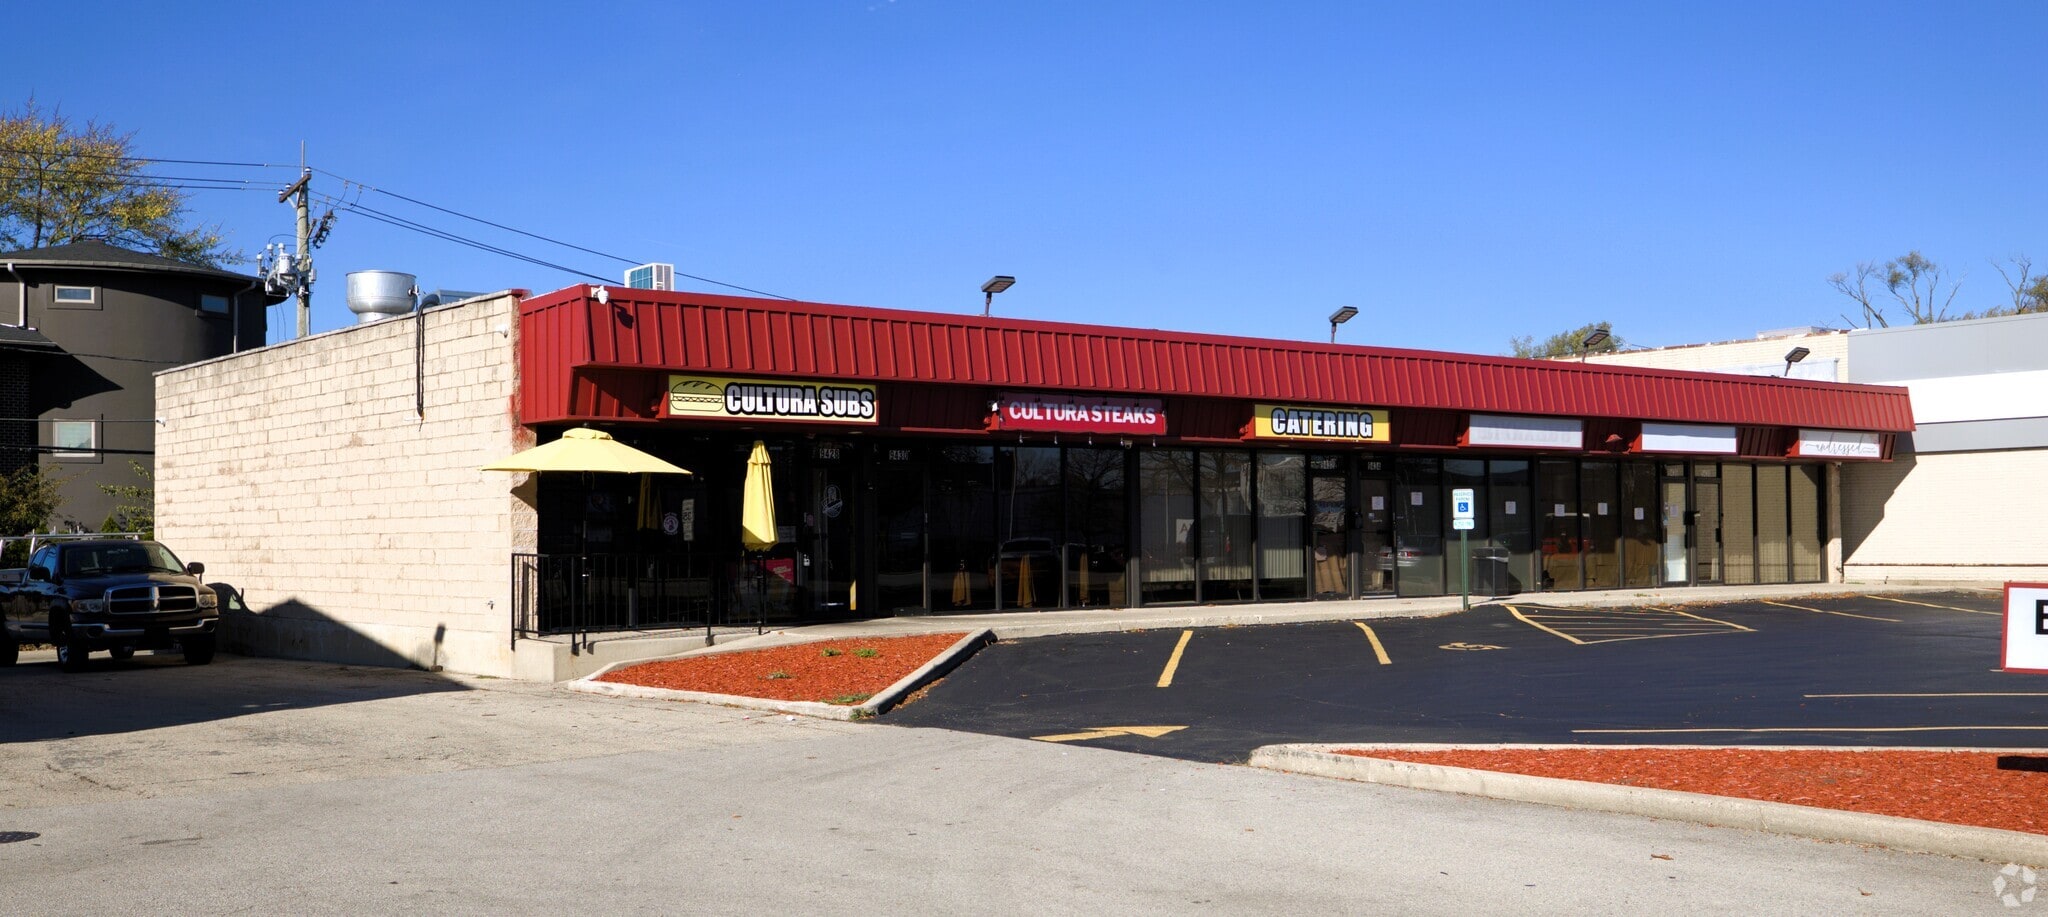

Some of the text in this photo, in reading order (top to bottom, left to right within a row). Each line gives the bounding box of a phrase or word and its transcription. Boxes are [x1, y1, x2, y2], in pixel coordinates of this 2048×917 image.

[725, 383, 875, 418] CULTURA SUBS
[1009, 402, 1156, 425] CULTURA STEAKS
[1272, 408, 1373, 437] CATERING
[819, 448, 840, 459] 9428
